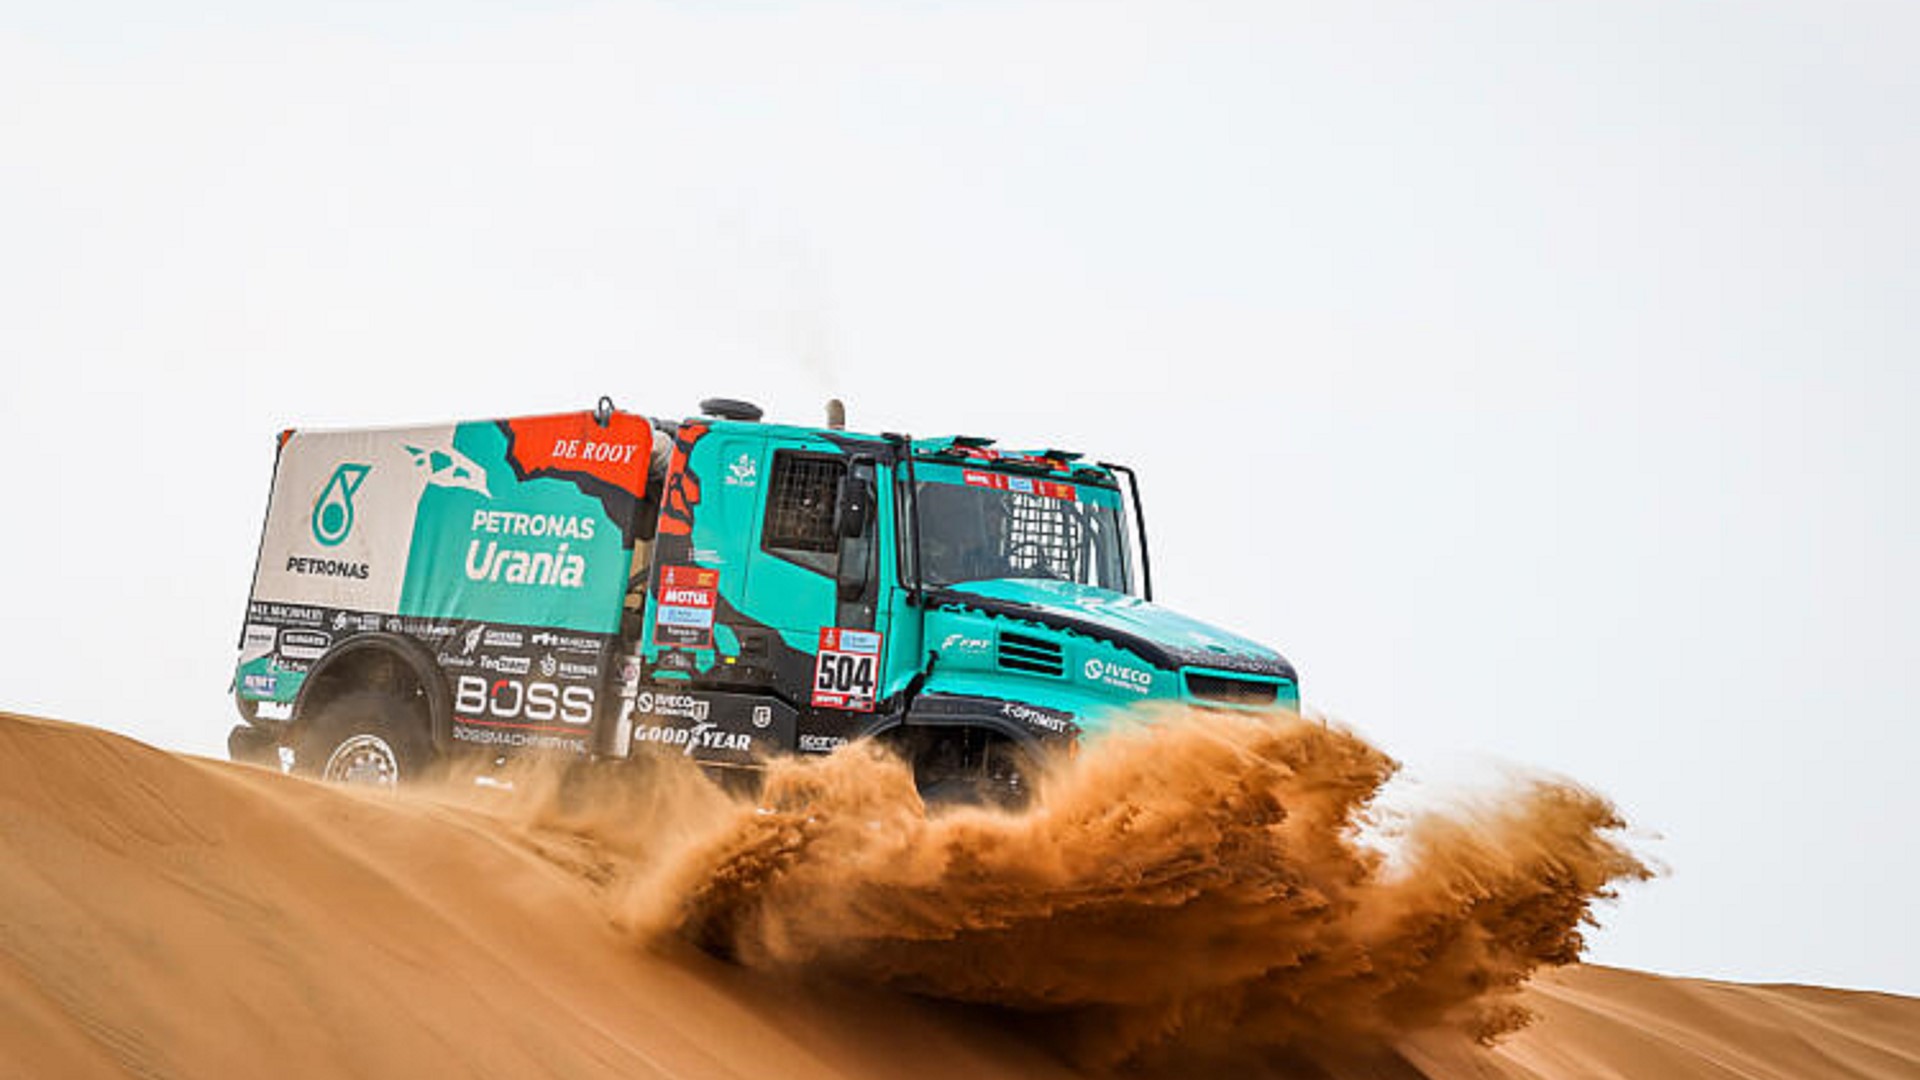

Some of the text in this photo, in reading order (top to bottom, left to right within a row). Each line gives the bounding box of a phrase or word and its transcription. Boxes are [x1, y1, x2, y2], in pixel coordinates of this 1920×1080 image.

[552, 439, 637, 463] DE ROOY
[471, 509, 596, 540] PETRONAS
[286, 556, 370, 580] PETRONAS
[664, 590, 709, 605] MOTUL
[818, 653, 873, 694] 504
[1105, 662, 1152, 685] IVECO
[455, 675, 595, 725] BOSS
